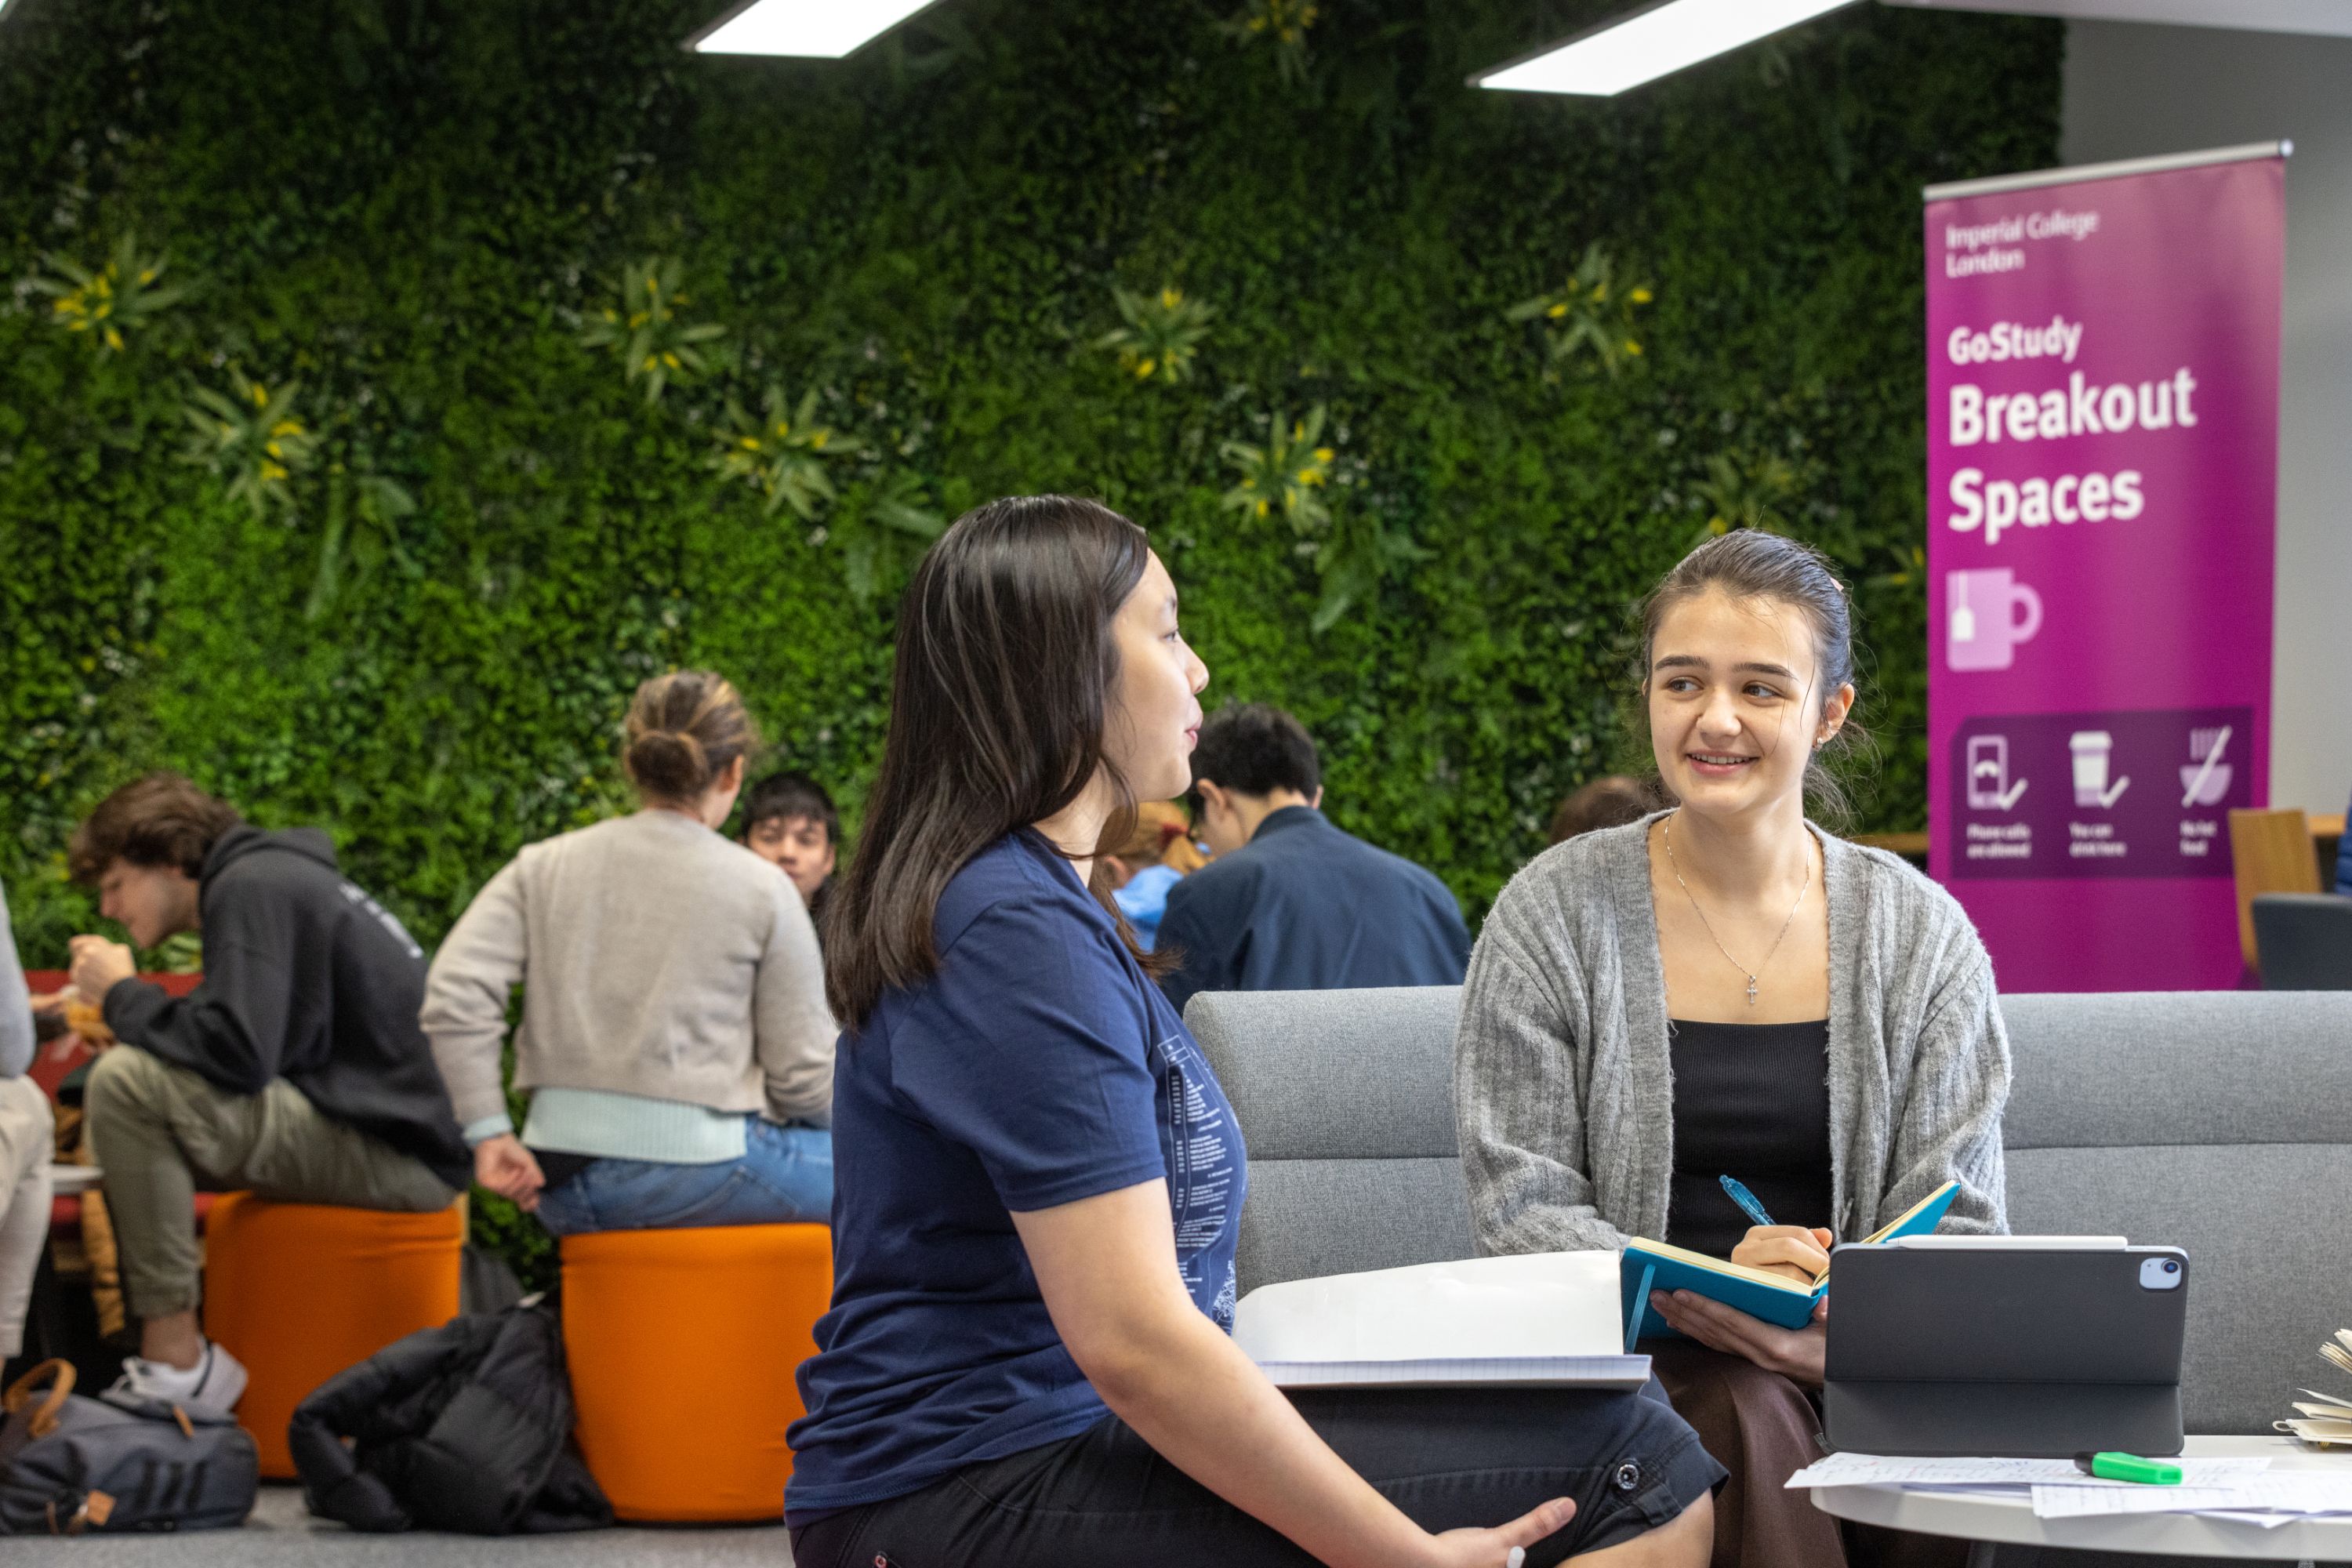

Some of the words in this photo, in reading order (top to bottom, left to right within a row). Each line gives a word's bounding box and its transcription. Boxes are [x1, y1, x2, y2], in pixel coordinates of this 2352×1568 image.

[1946, 214, 2025, 253] Imperial
[2026, 209, 2100, 241] College
[1946, 246, 2025, 278] London
[1948, 315, 2083, 365] GoStudy
[1950, 366, 2198, 446] Breakout
[1948, 467, 2145, 545] Spaces
